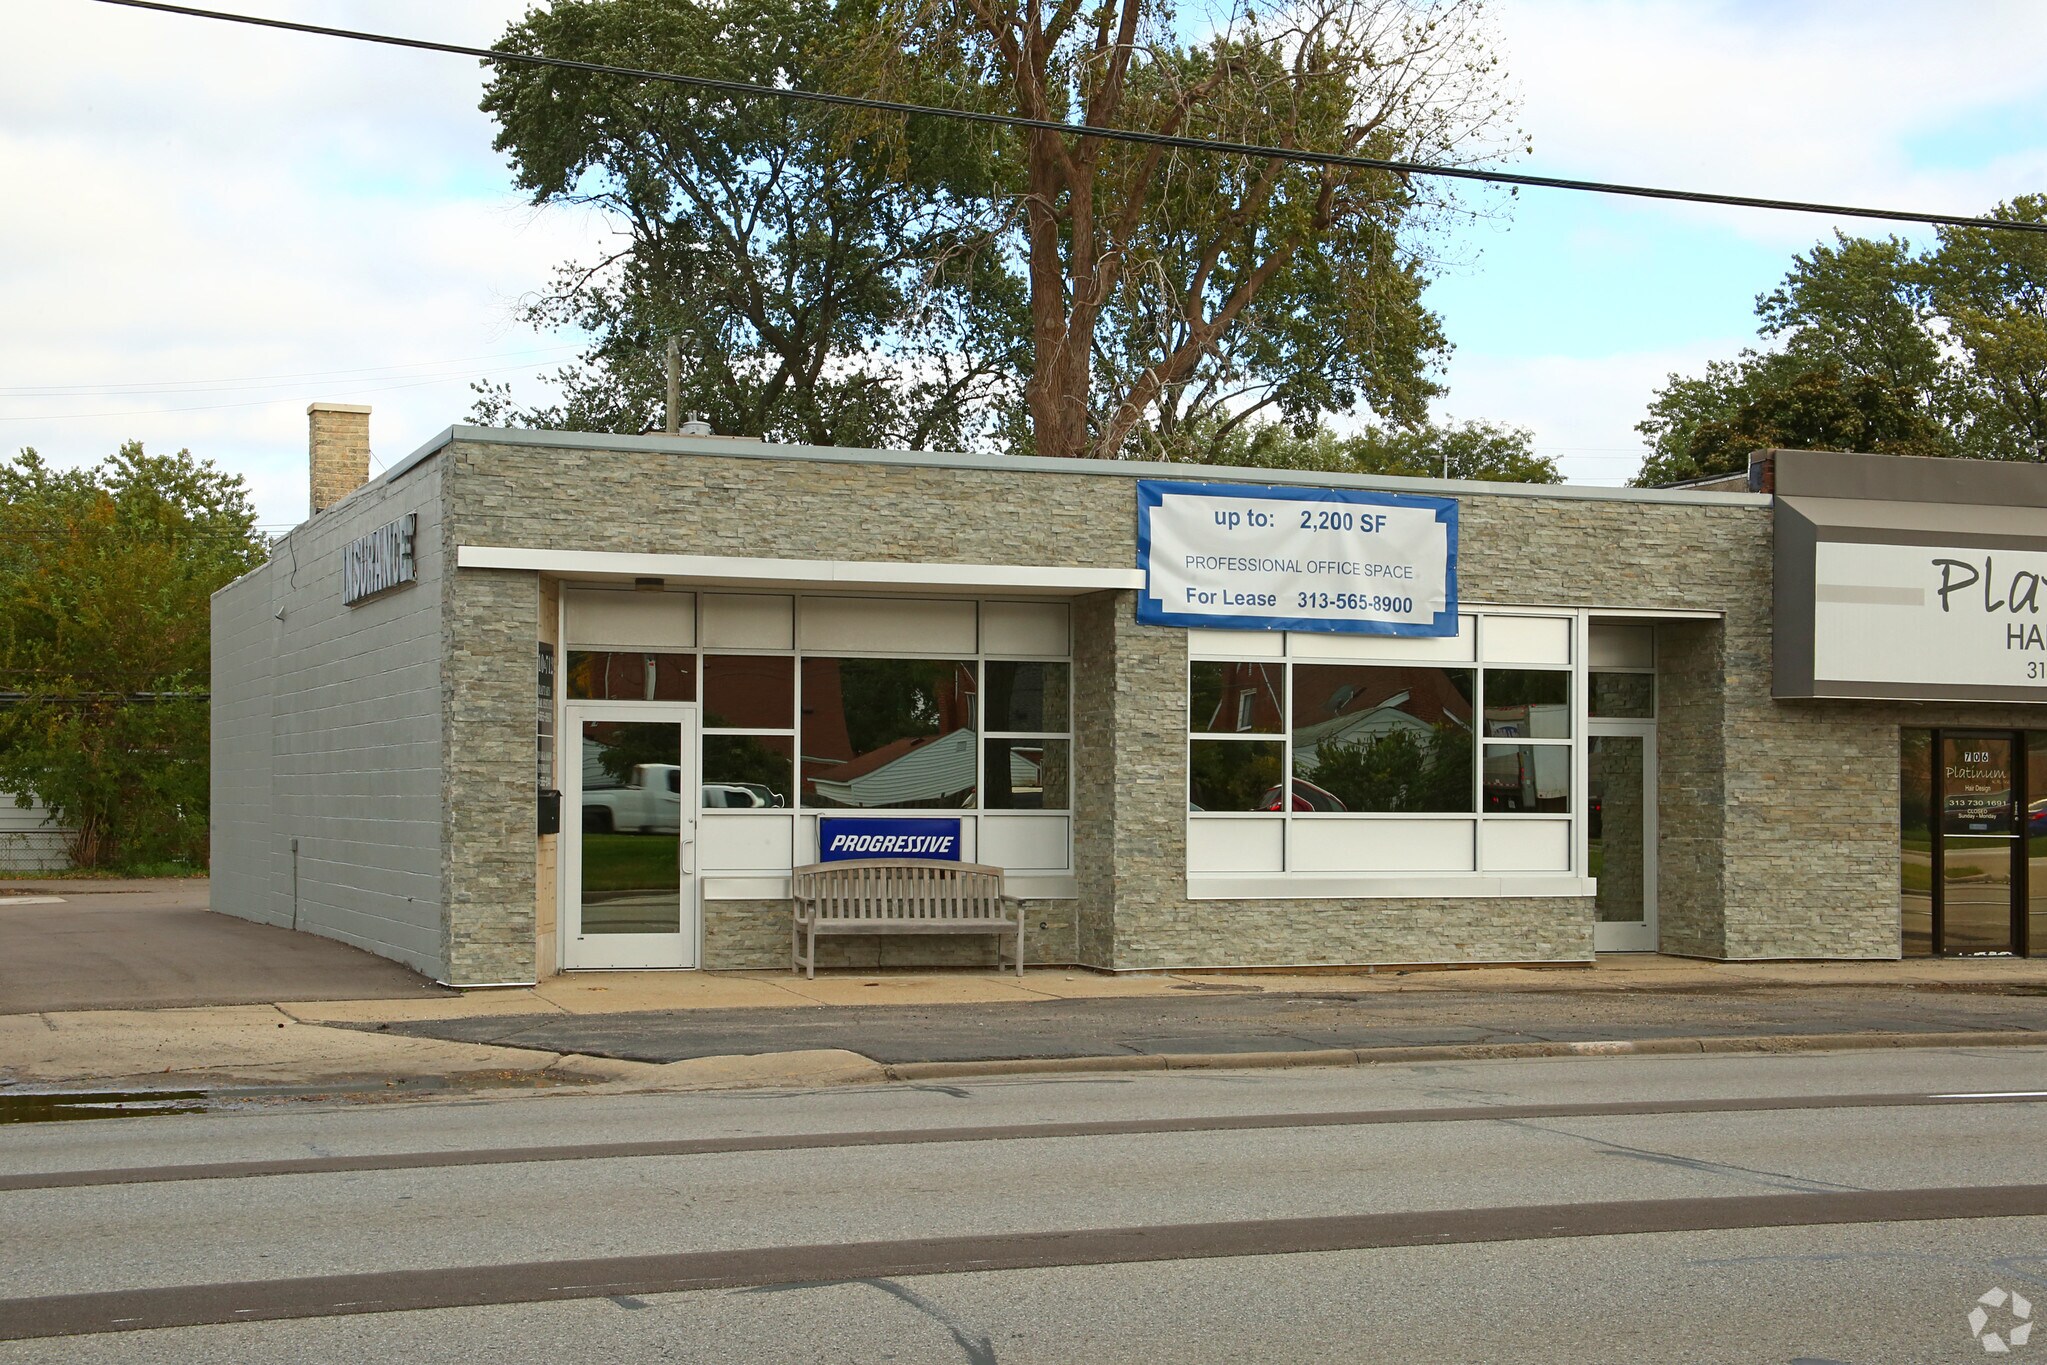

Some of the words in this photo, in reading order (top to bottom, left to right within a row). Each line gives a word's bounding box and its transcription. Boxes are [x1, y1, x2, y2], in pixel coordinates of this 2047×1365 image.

[1214, 510, 1241, 531] up
[1247, 508, 1275, 528] to:
[1299, 510, 1353, 533] 2,200
[1359, 513, 1387, 533] SF
[343, 513, 416, 605] INSURANCE
[1185, 555, 1303, 573] PROFESSIONAL
[1306, 560, 1361, 576] OFFICE
[1363, 563, 1414, 579] SPACE
[1931, 555, 2047, 614] Pla
[1185, 587, 1217, 605] For
[1222, 589, 1277, 607] Lease
[1297, 591, 1413, 614] 313-565-8900
[2007, 622, 2047, 651] HA
[1965, 752, 1989, 762] 706
[1946, 766, 2006, 778] Platinum
[1975, 785, 1991, 793] Design
[829, 834, 955, 853] PROGRESSIVE
